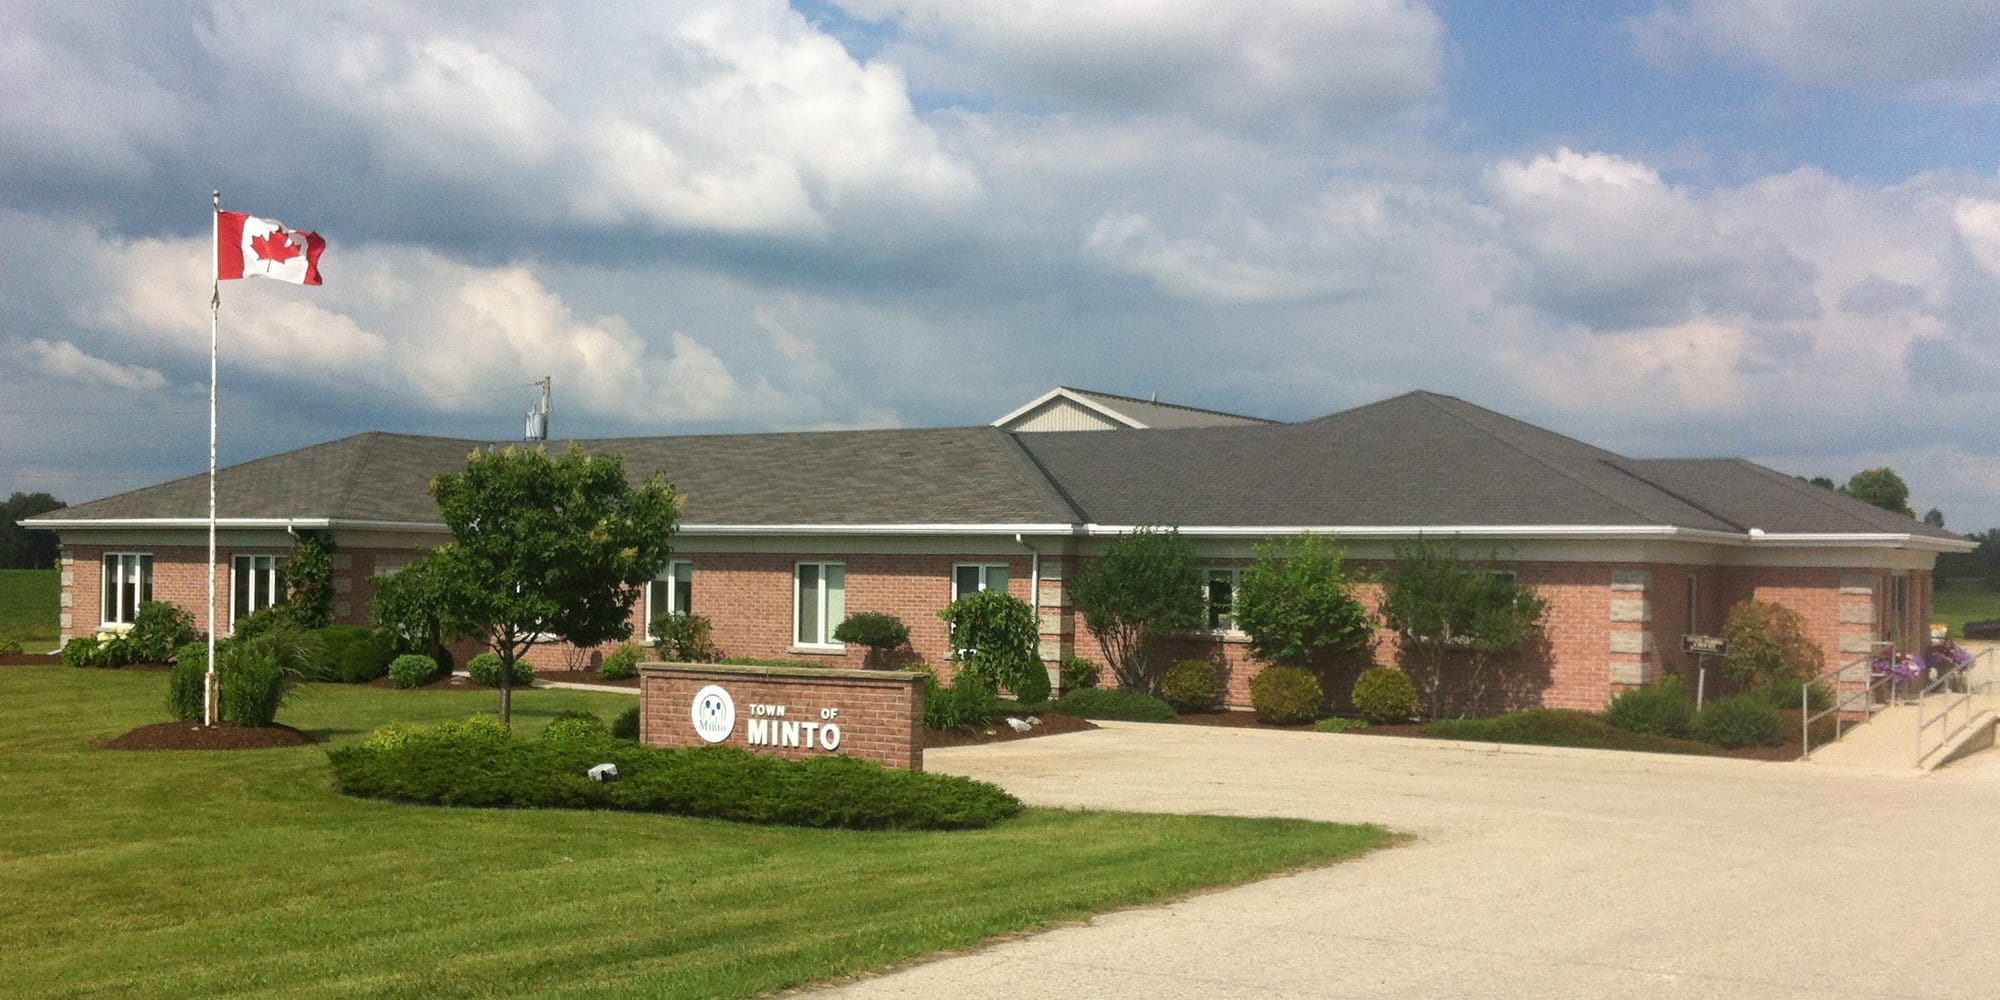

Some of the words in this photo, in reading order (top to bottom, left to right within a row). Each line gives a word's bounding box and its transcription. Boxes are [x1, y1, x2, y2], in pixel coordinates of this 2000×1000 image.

[750, 703, 785, 716] TOWN
[820, 708, 839, 720] OF
[699, 719, 727, 733] Minto
[748, 719, 841, 750] MINTO
